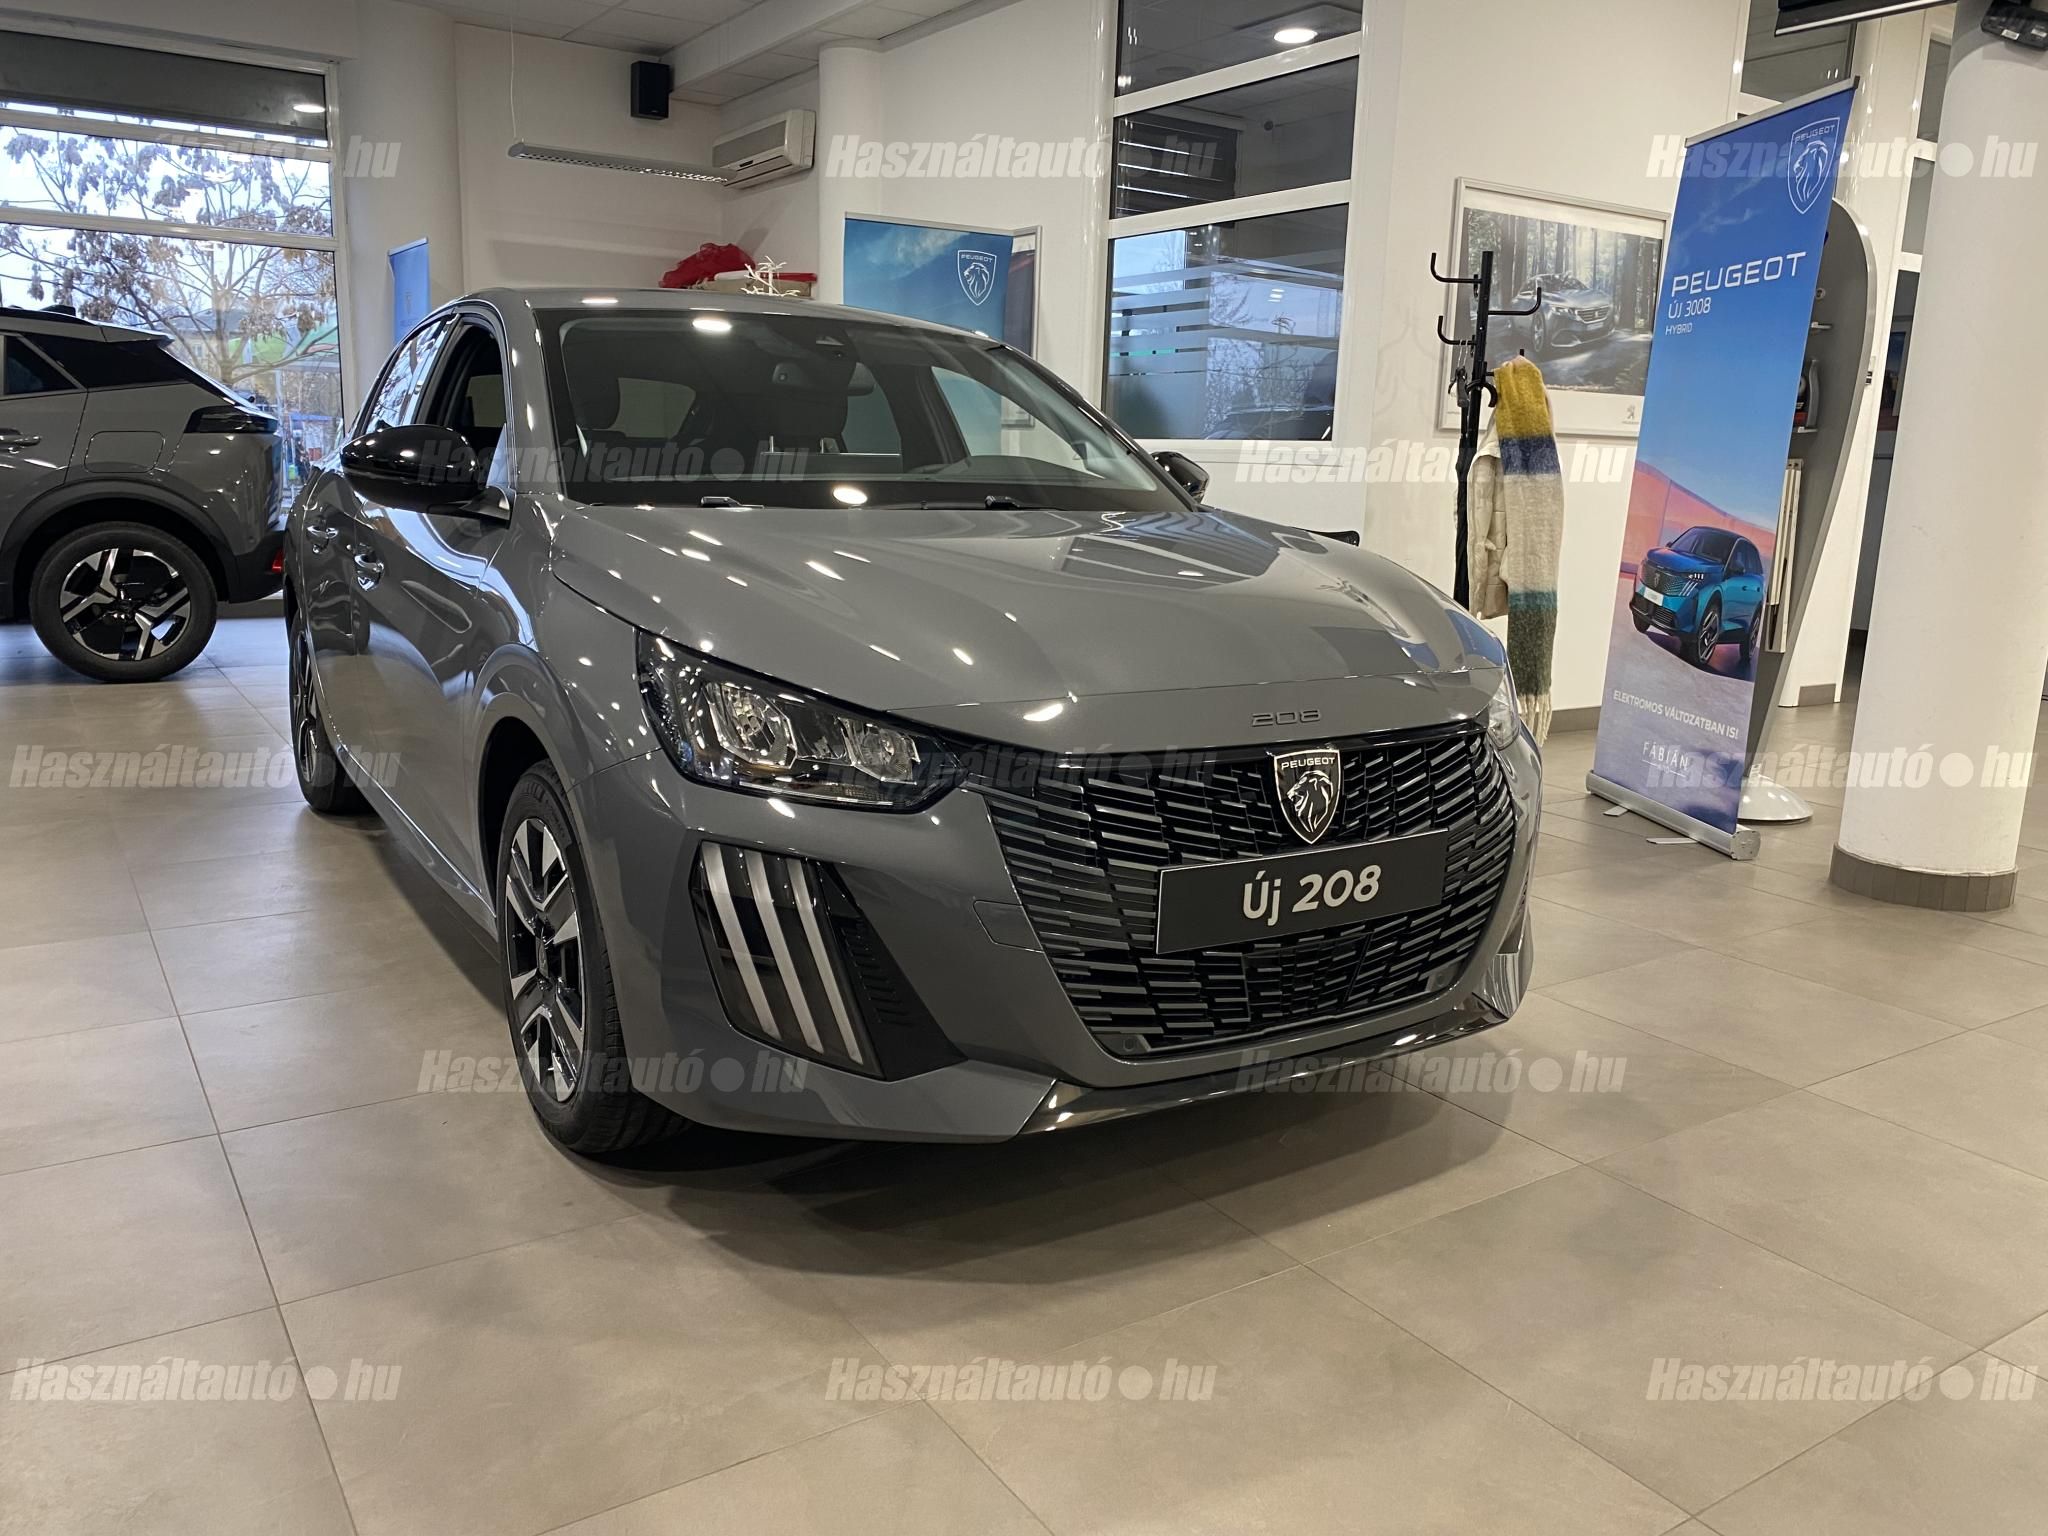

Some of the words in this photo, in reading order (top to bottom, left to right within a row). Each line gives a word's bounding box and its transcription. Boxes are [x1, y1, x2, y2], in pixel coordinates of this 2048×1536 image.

[1795, 125, 1836, 144] PEUGEOT
[961, 254, 993, 263] PEUGEOT
[1671, 251, 1807, 298] PEUGEOT
[1668, 300, 1682, 319] ÚJ
[1684, 297, 1712, 318] 3008
[1665, 322, 1693, 336] HYBRID
[1251, 709, 1322, 728] 208
[1613, 690, 1664, 715] ELEKTROMOS
[1664, 704, 1726, 736] VÁLTOZATBAN
[1725, 725, 1739, 740] IS!
[1281, 757, 1336, 771] PEUGEOT
[1642, 741, 1689, 771] FÁBIÁN
[1242, 869, 1282, 927] Új
[1291, 864, 1383, 913] 208
